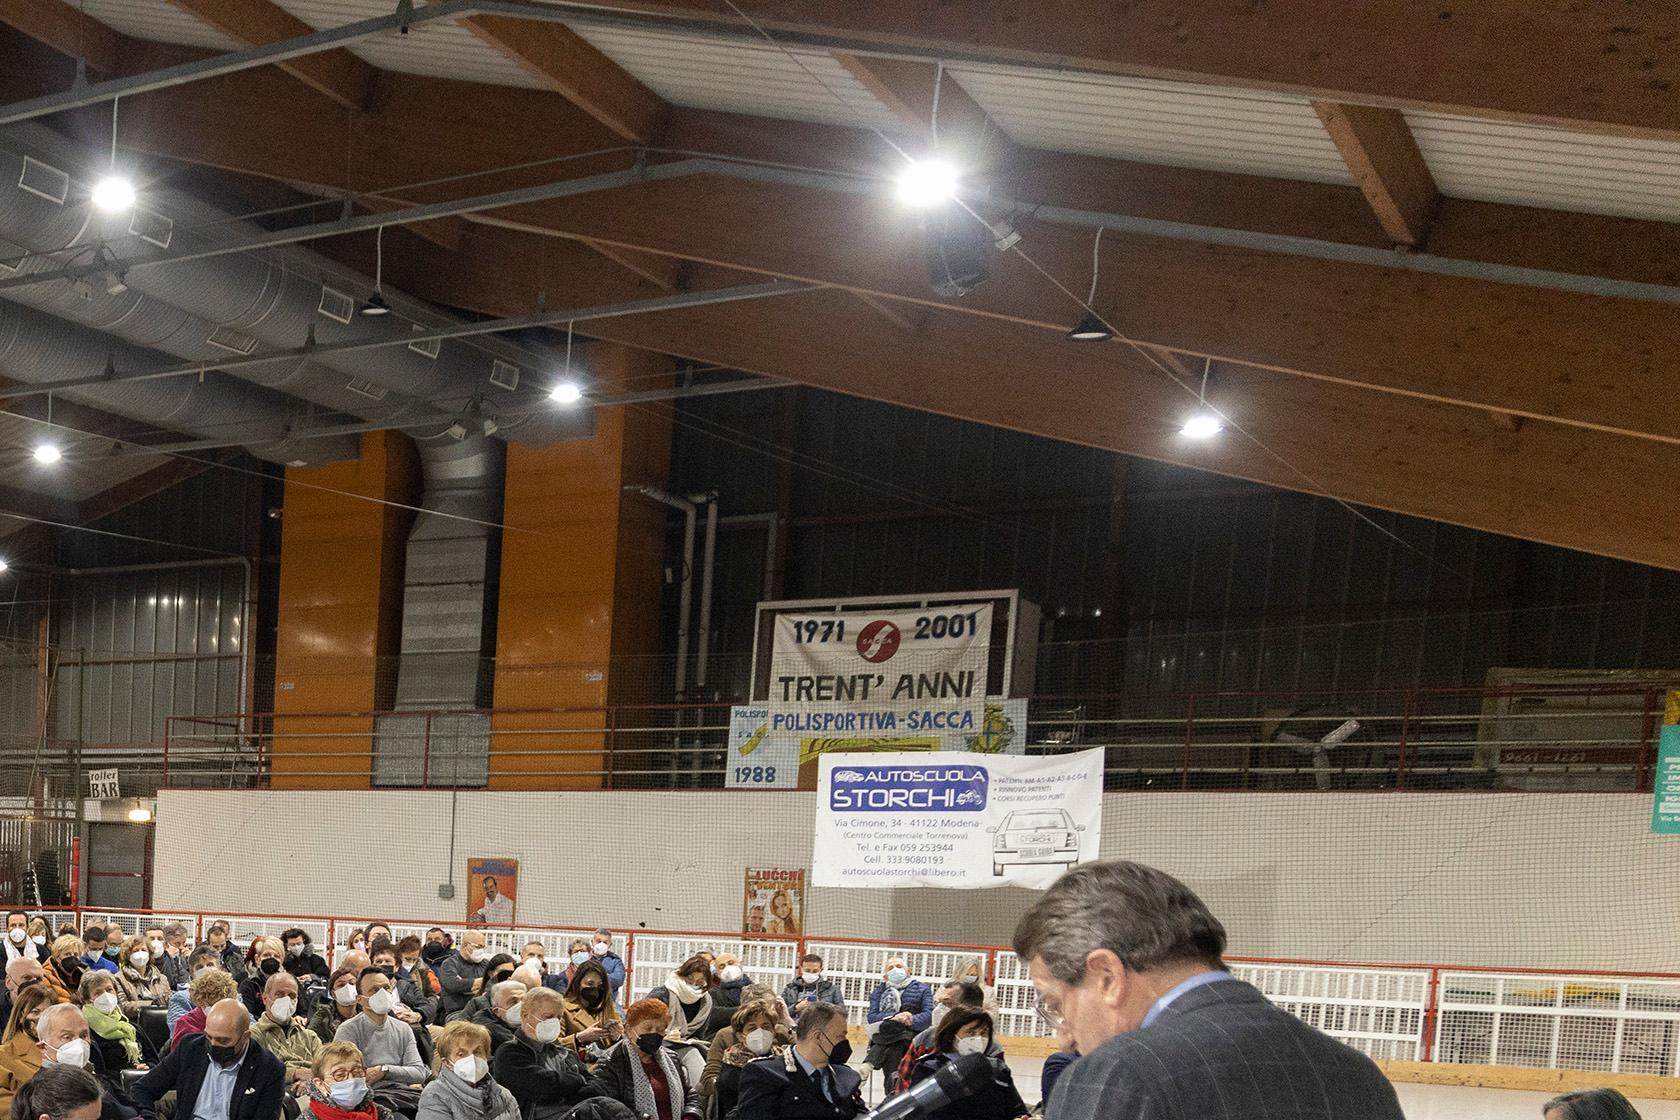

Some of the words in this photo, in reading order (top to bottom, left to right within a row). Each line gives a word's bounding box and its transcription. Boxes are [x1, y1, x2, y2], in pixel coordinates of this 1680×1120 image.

[793, 619, 845, 644] 1971
[914, 613, 976, 640] 2001
[891, 670, 975, 700] ANNI
[91, 771, 116, 780] roller
[735, 766, 777, 783] 1988
[864, 770, 986, 783] AUTOSCUOLA
[91, 782, 118, 798] BAR
[833, 788, 955, 808] STORCHI
[834, 818, 848, 828] Via
[850, 818, 888, 829] Cimone,
[890, 818, 902, 828] 34
[909, 818, 938, 828] 41122
[940, 818, 980, 828] Modena
[843, 831, 872, 840] (Centro
[873, 831, 924, 840] Commerciale
[926, 831, 969, 841] Torrenova)
[856, 842, 872, 852] Tel.
[874, 844, 881, 852] e
[882, 843, 898, 852] Fax
[900, 843, 917, 852] 059
[919, 843, 954, 852] 253944
[841, 867, 967, 877] autoscuolastorchi@libero.it
